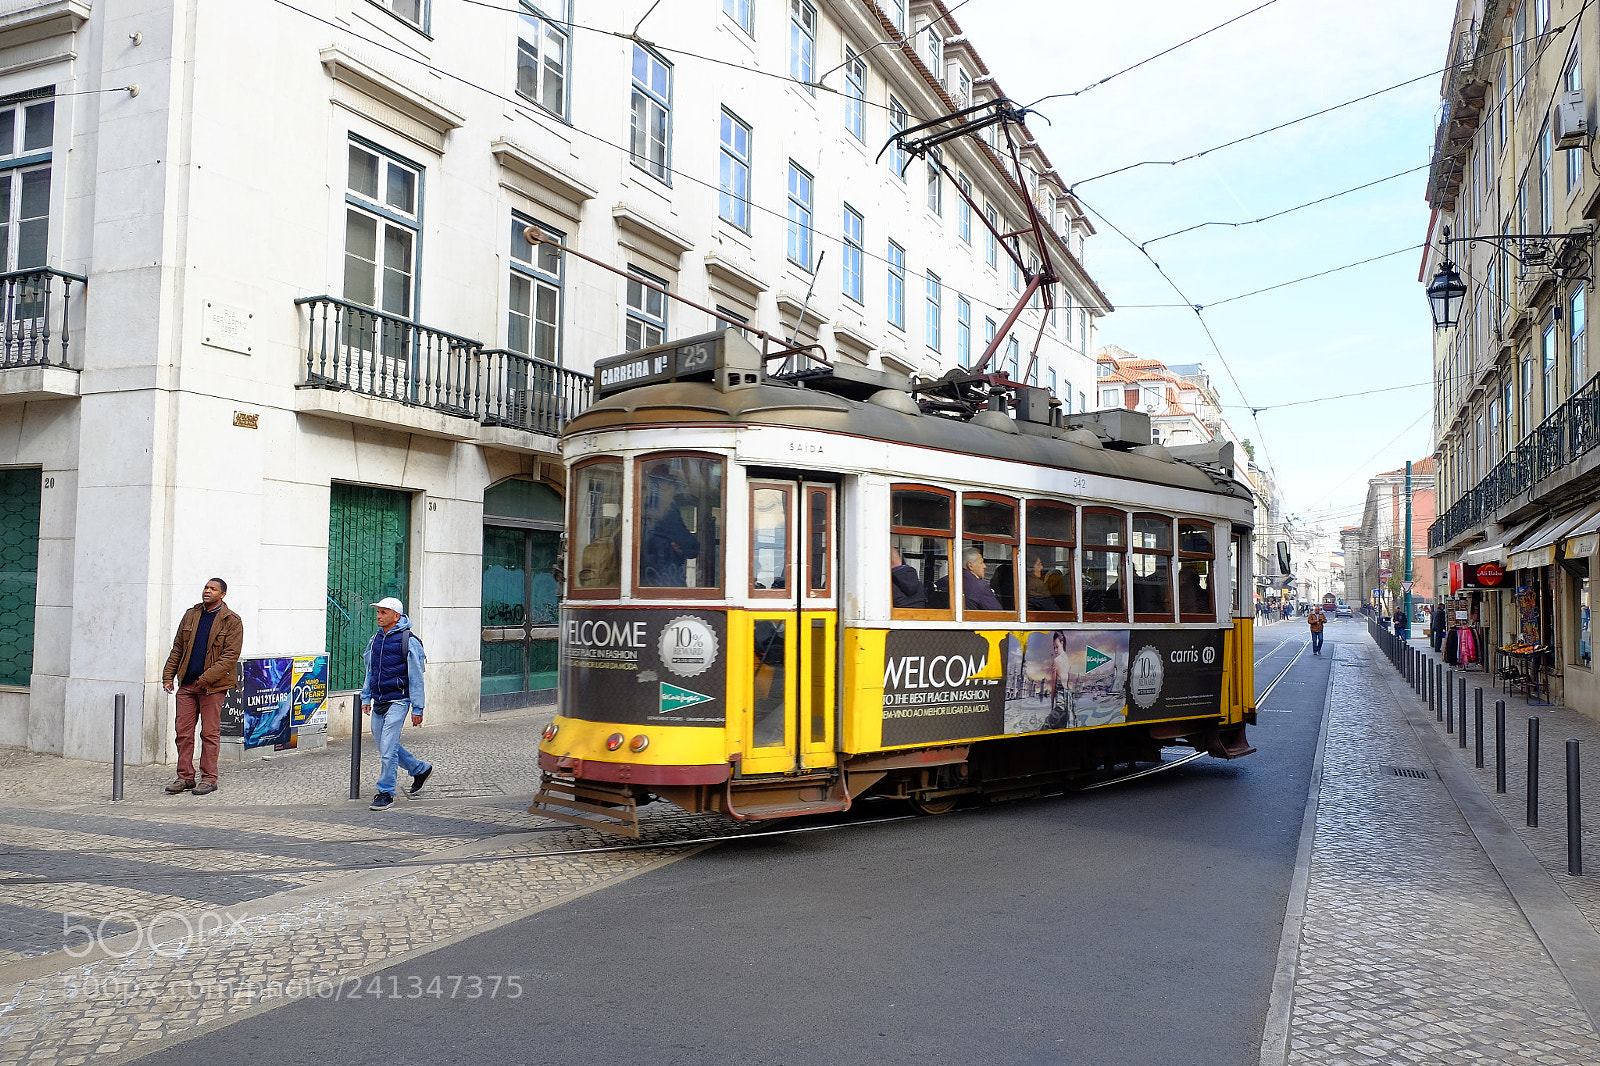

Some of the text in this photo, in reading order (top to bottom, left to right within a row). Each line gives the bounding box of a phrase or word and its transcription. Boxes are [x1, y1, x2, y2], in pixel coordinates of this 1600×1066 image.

[601, 360, 650, 386] CARREIRA
[683, 343, 708, 368] 25
[583, 436, 598, 450] 542
[789, 441, 825, 454] SAÍDA
[44, 477, 55, 489] 20
[1073, 476, 1086, 489] 542
[428, 502, 437, 512] 30
[670, 626, 704, 648] 10%
[605, 649, 638, 660] FASHION
[1170, 645, 1199, 663] carris
[883, 654, 999, 690] WELCOM
[247, 692, 288, 707] LXN12YEARS
[293, 685, 311, 705] 20
[304, 690, 325, 698] YEARS
[882, 689, 990, 706] TO THE BEST PLACE IN FASHION
[882, 709, 913, 720] EM-VINDO
[914, 708, 923, 717] AO
[972, 704, 990, 713] MODA
